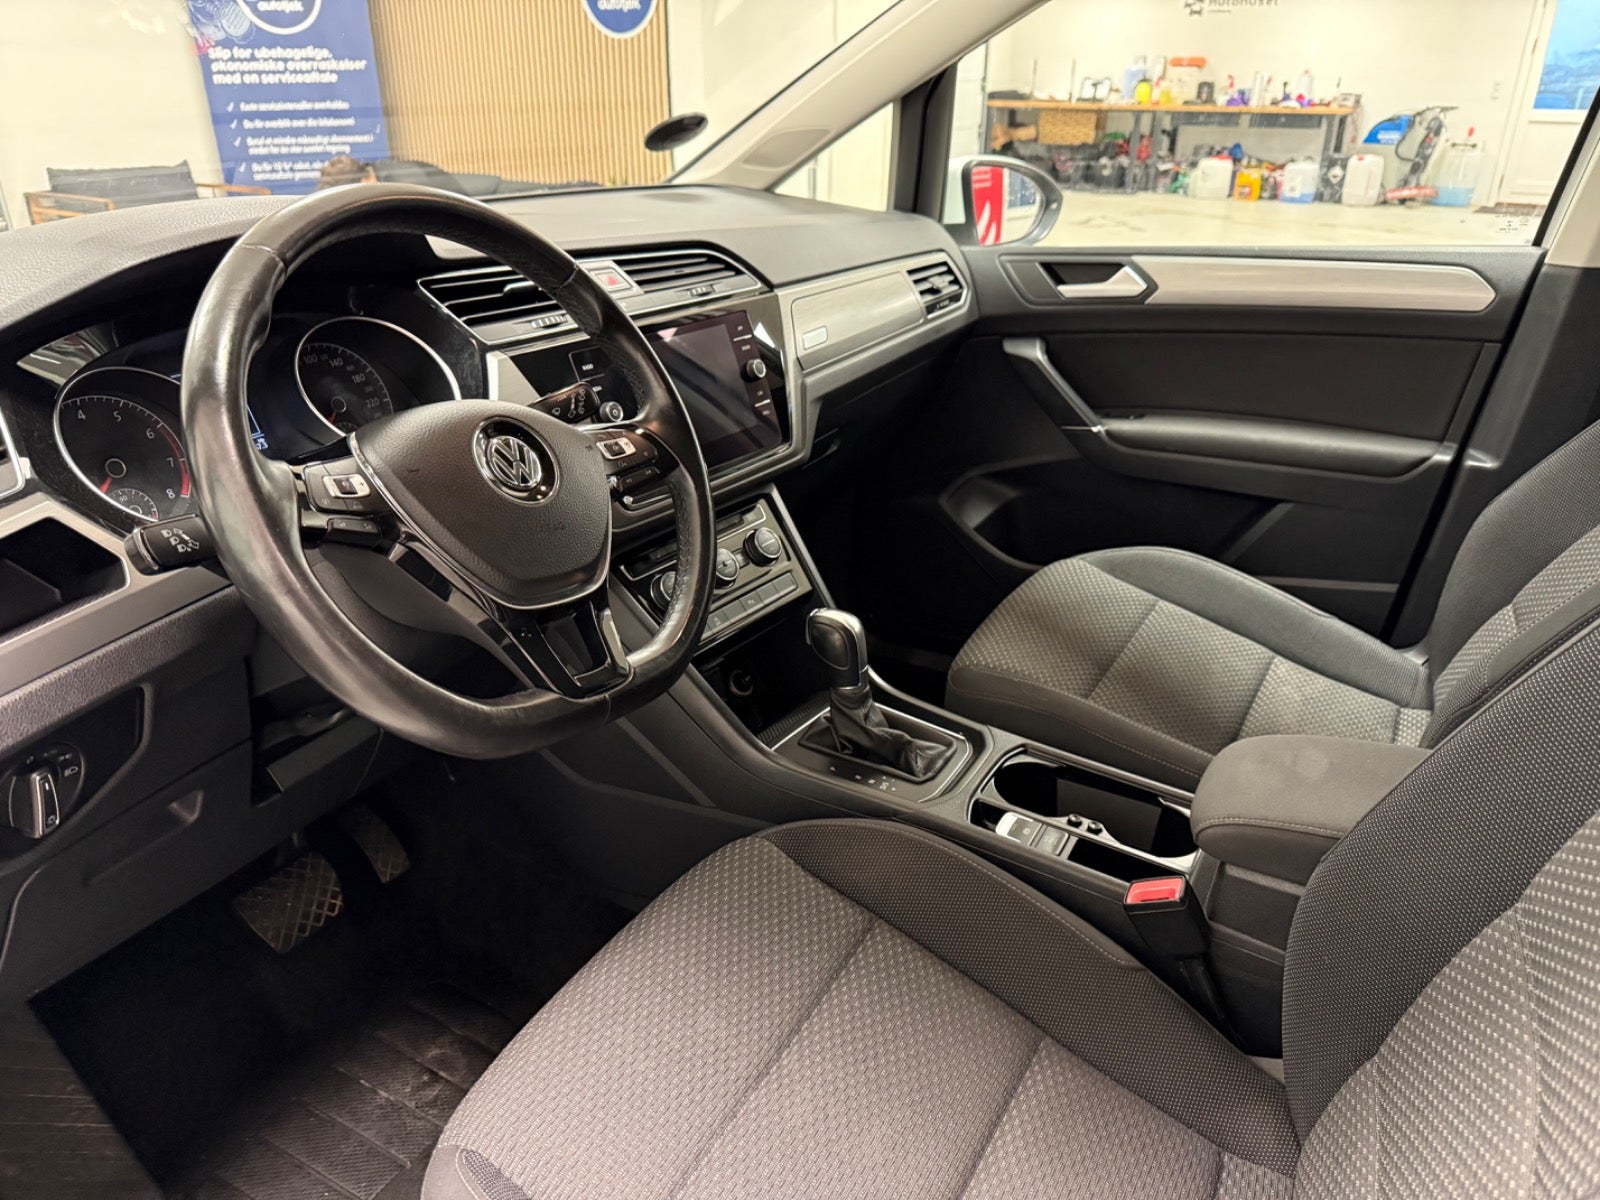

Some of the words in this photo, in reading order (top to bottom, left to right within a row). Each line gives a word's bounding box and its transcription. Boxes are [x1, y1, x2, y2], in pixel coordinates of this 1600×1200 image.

[233, 46, 252, 59] for
[212, 73, 242, 85] med
[243, 75, 260, 84] en
[77, 410, 86, 421] 4
[113, 410, 122, 422] 5
[146, 428, 155, 440] 6
[166, 457, 175, 468] 7
[166, 488, 175, 499] 8
